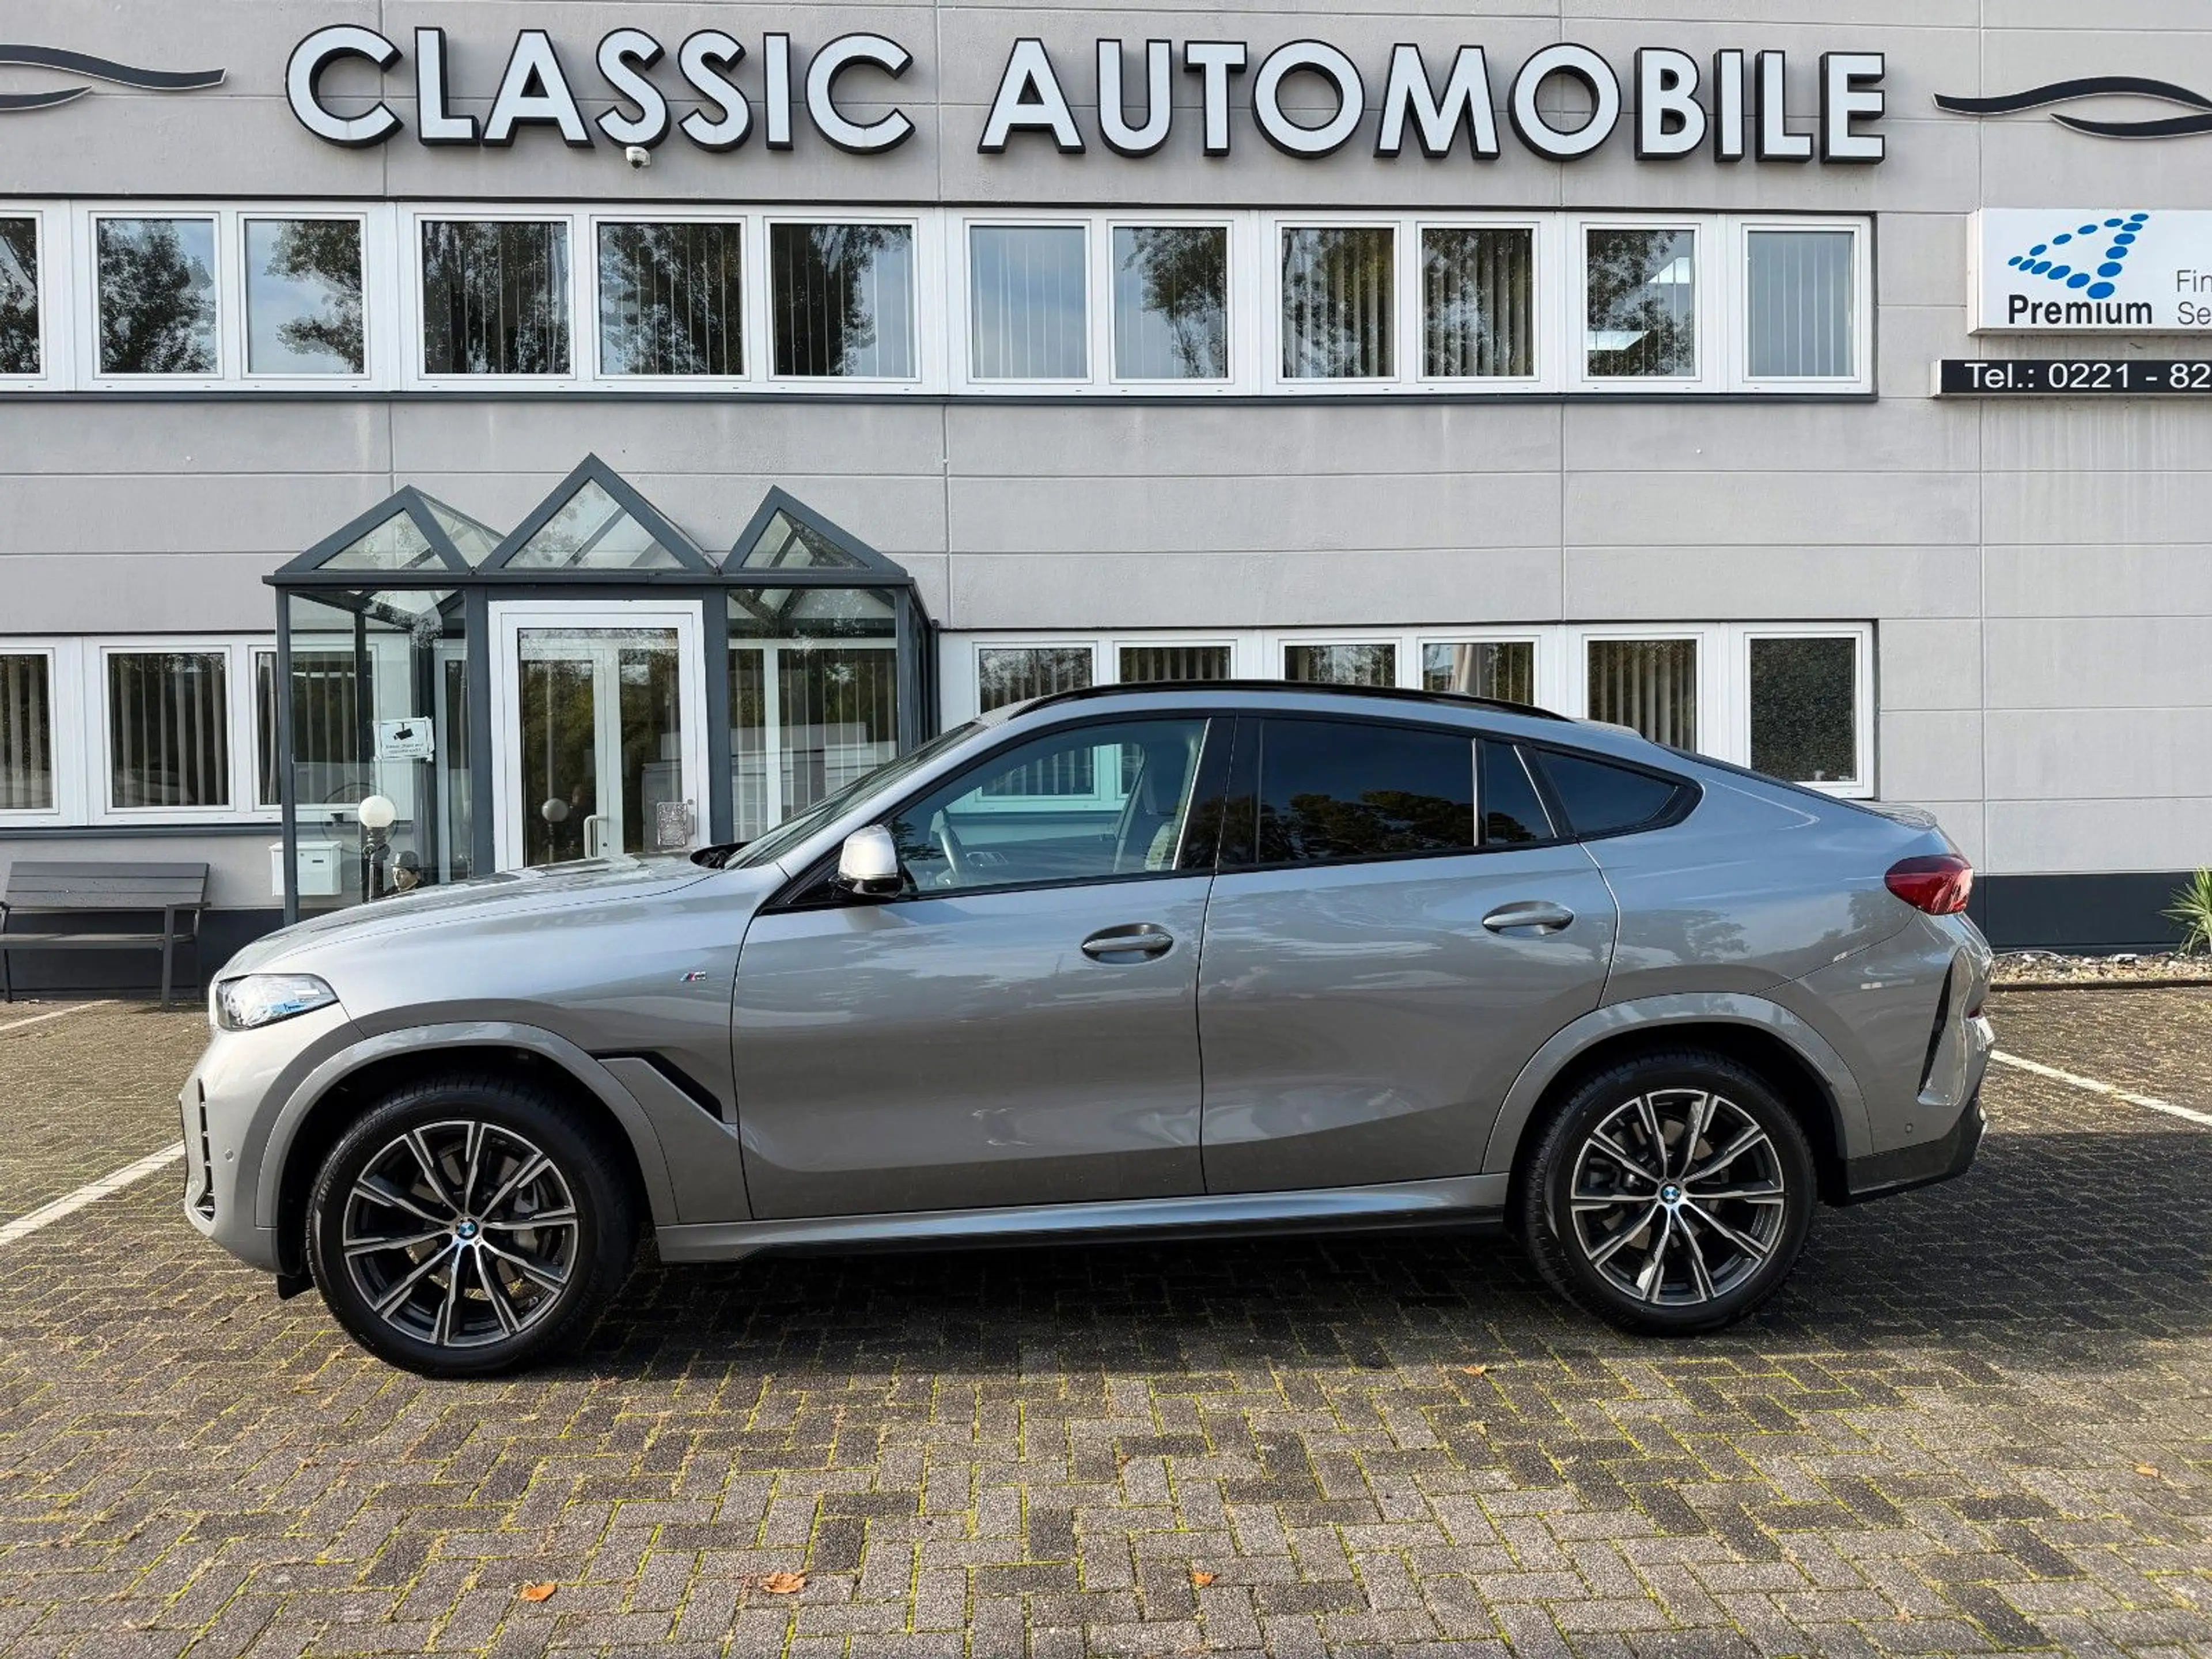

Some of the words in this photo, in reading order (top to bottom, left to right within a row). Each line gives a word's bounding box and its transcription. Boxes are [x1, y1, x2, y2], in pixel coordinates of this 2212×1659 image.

[285, 24, 916, 154] CLASSIC
[978, 36, 1887, 165] AUTOMOBILE
[2177, 269, 2212, 293] Fin
[2008, 294, 2153, 324] Premium
[2177, 301, 2211, 325] Se
[1964, 363, 2035, 388] Tel.:
[2048, 363, 2129, 389] 0221
[2169, 363, 2211, 389] 82
